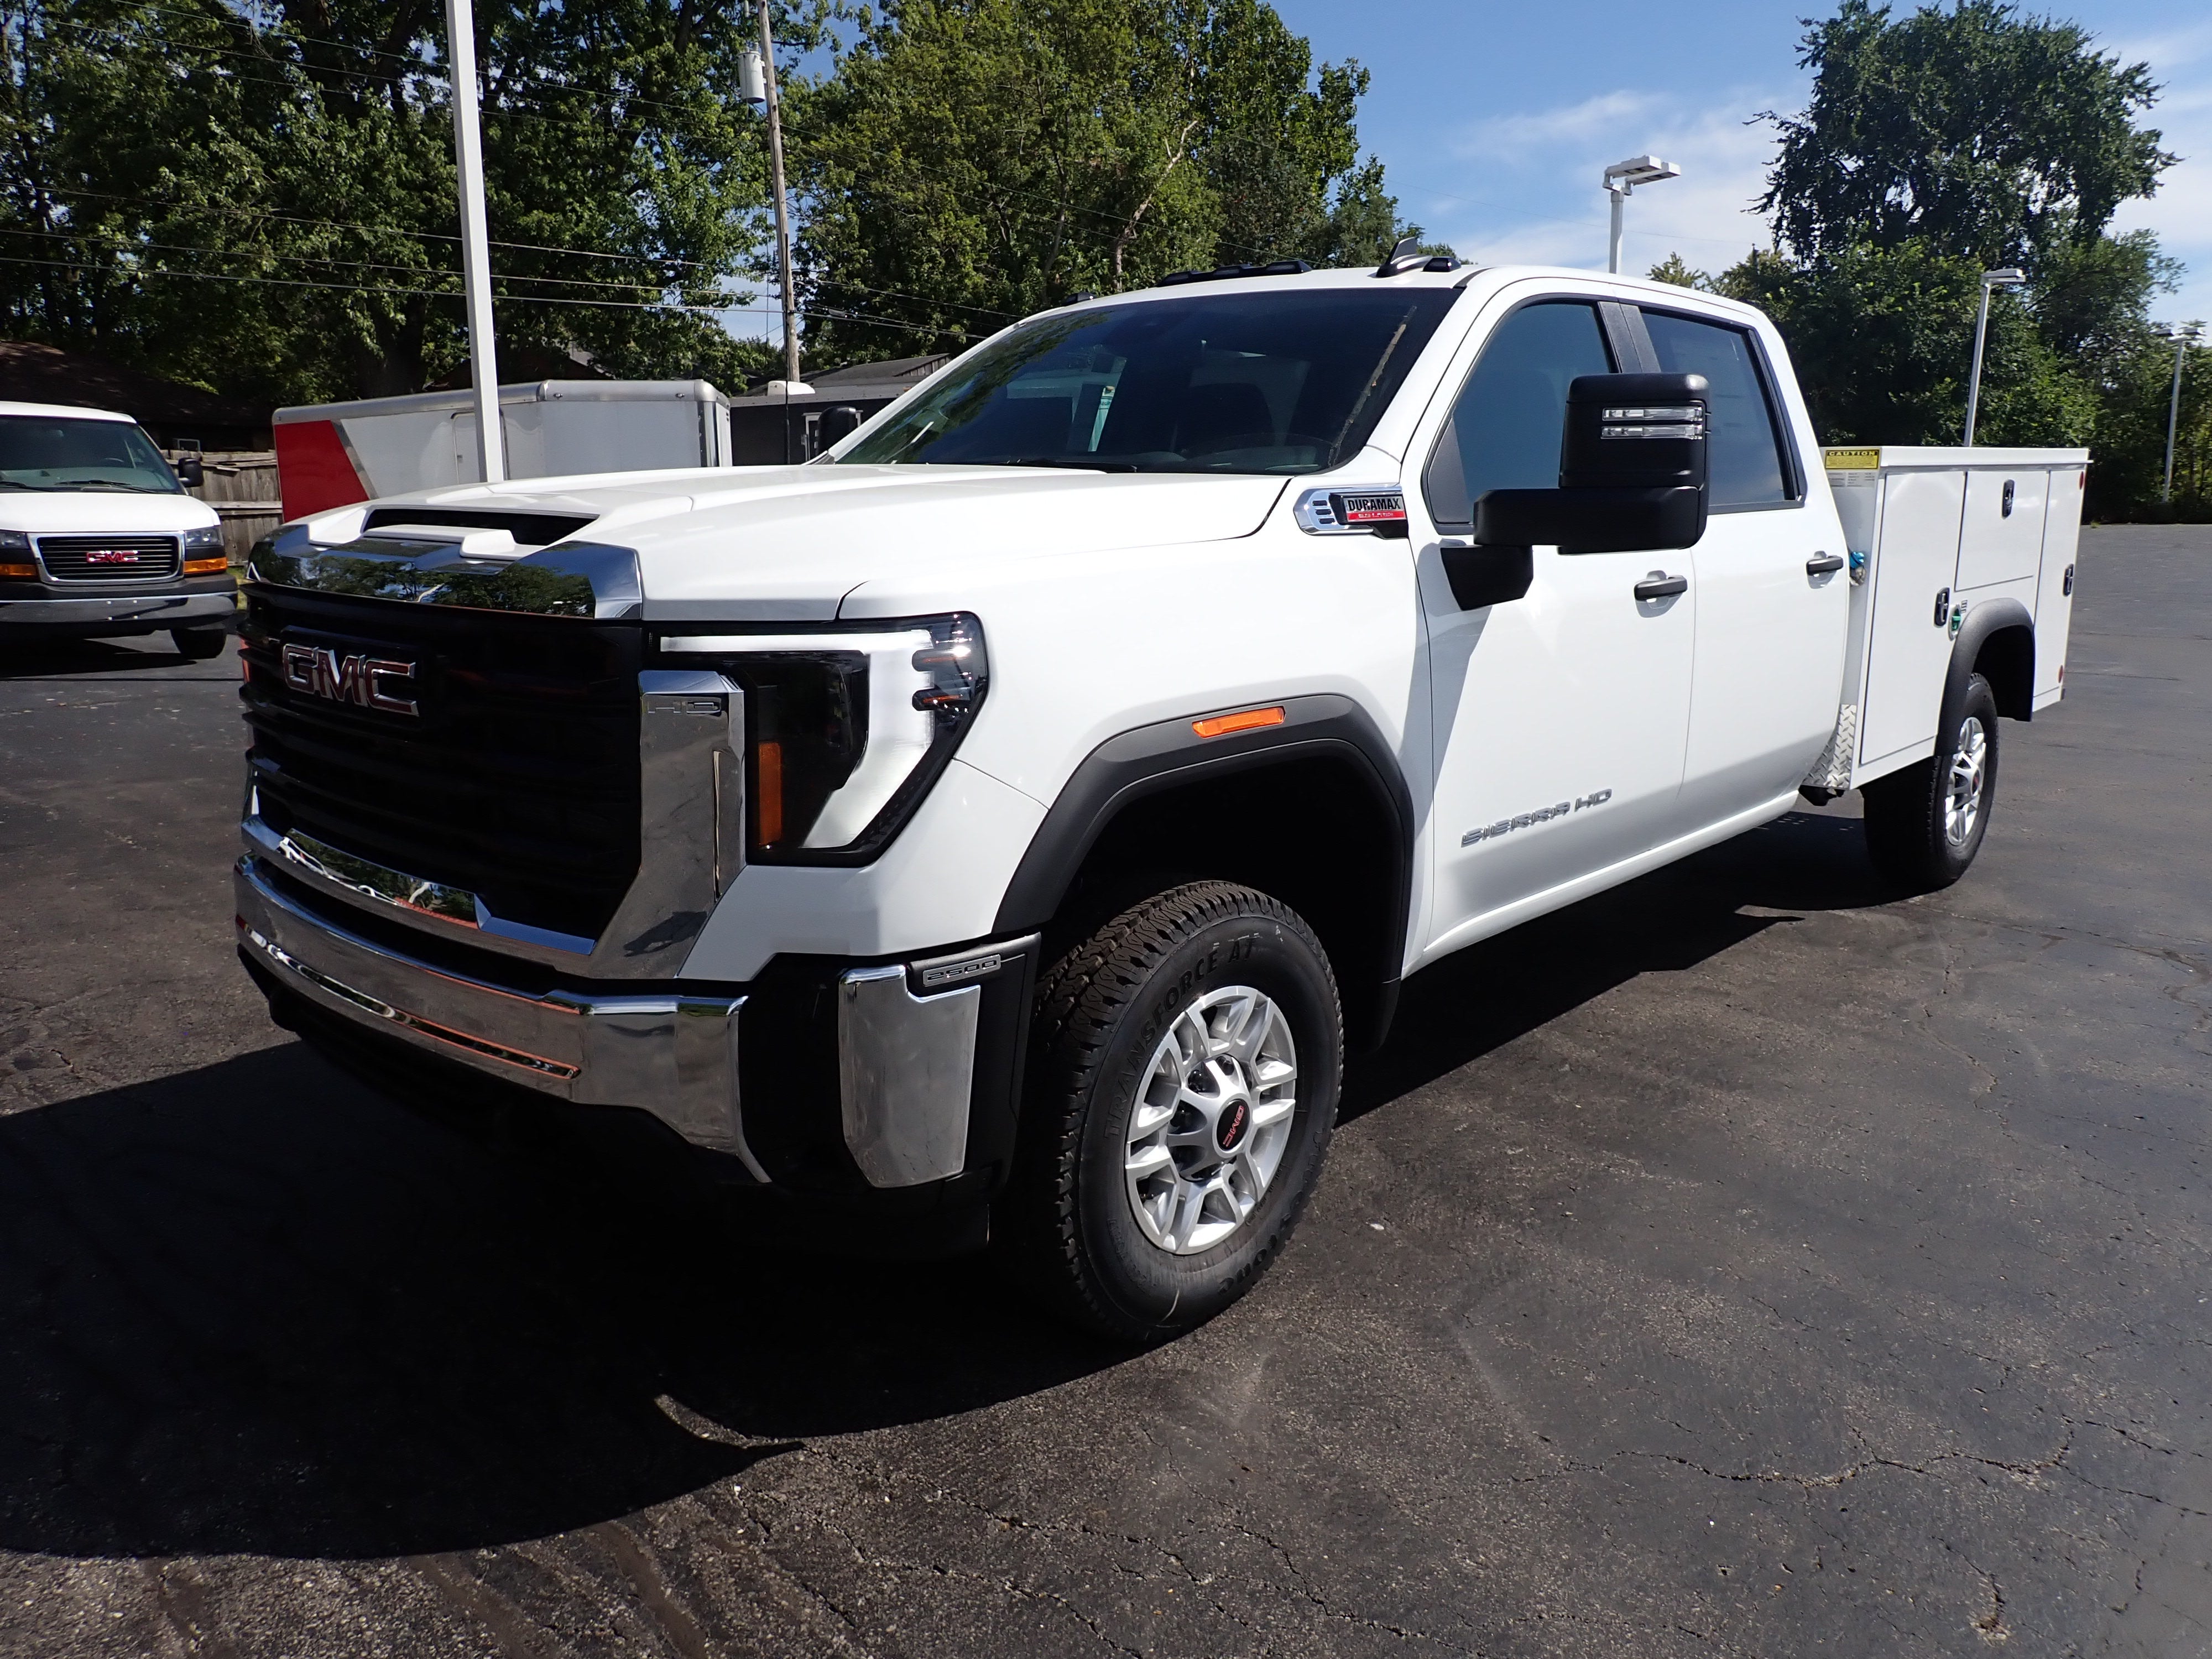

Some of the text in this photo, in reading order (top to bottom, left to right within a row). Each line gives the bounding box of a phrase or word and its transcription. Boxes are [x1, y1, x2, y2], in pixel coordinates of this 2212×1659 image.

[1348, 497, 1401, 511] DURAMAX
[87, 550, 138, 563] GMC
[283, 643, 419, 717] GMC
[648, 697, 721, 714] HD
[1460, 788, 1613, 848] SIERRA HD
[927, 960, 997, 982] 2500
[1103, 947, 1219, 1138] TRANSFORCE
[1227, 936, 1256, 964] AT
[1222, 1105, 1244, 1147] GMC
